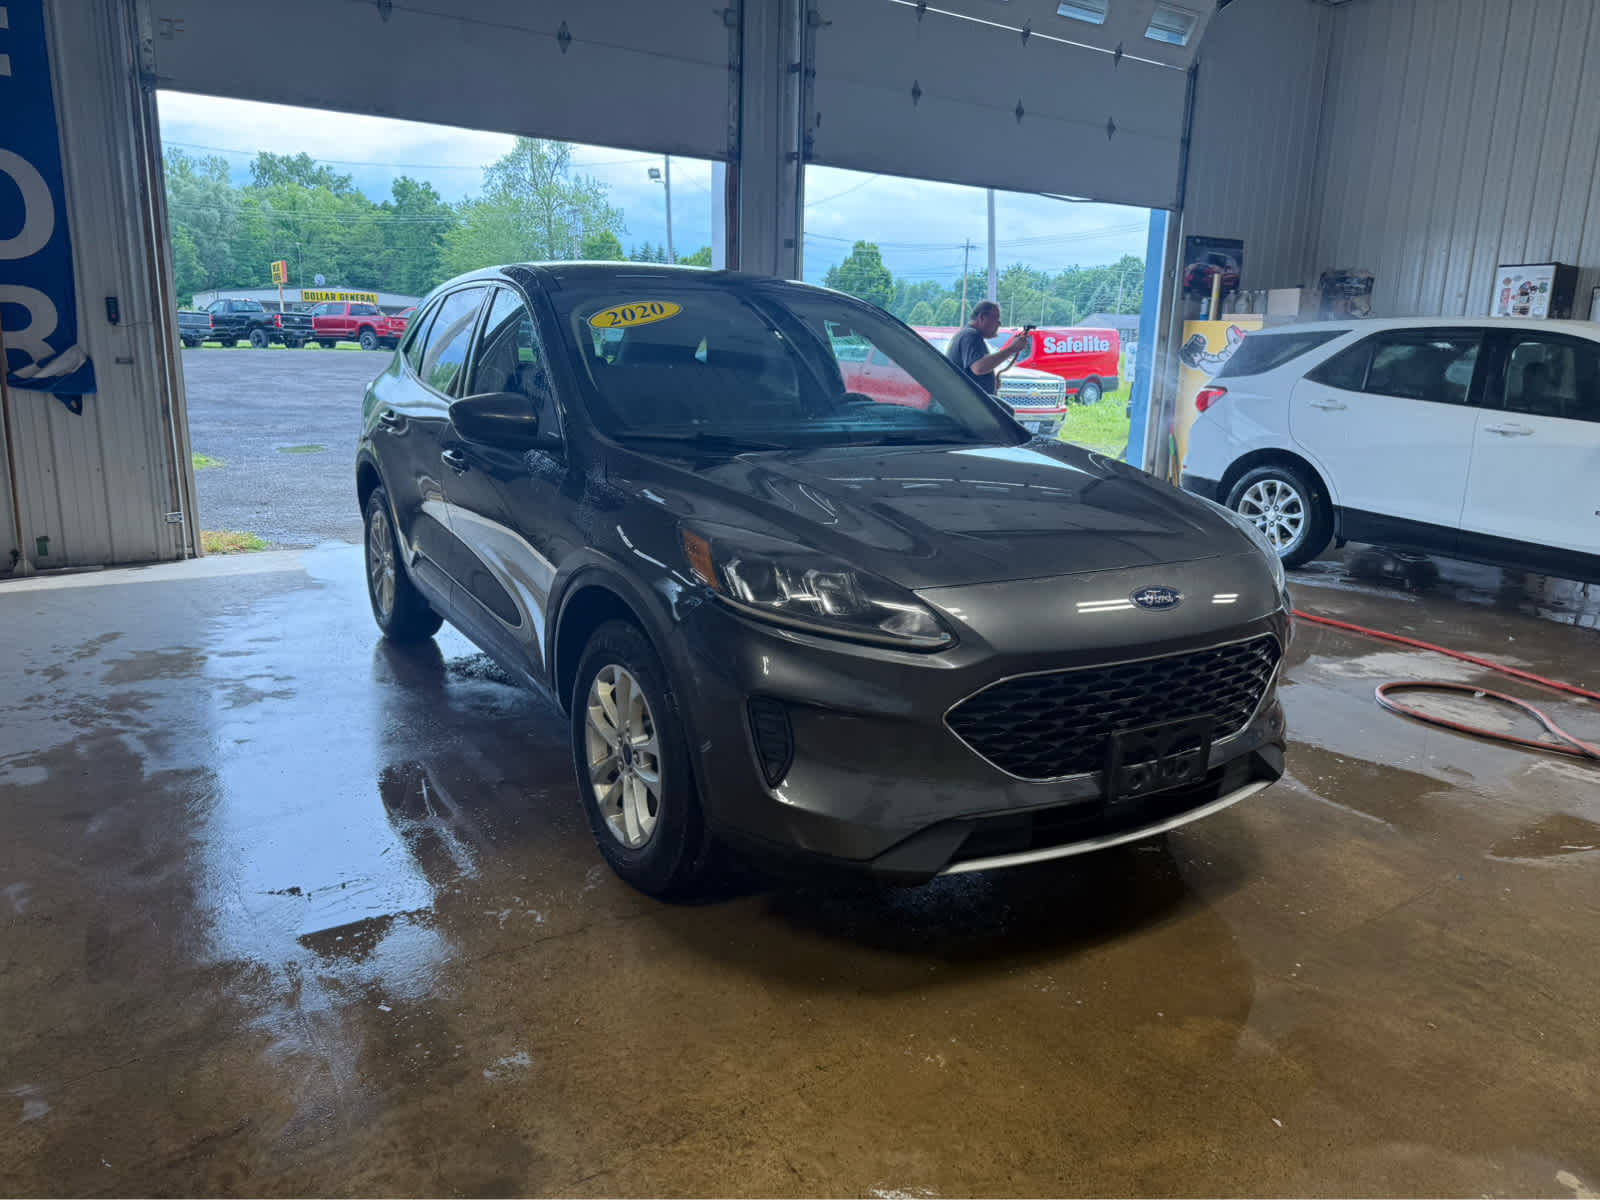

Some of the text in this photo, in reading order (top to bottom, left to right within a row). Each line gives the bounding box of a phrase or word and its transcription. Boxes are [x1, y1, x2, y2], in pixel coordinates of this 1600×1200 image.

[303, 291, 376, 303] DOLLAR GENERAL
[606, 303, 665, 326] 2020
[1043, 336, 1110, 353] Safelite
[1144, 590, 1174, 606] Ford
